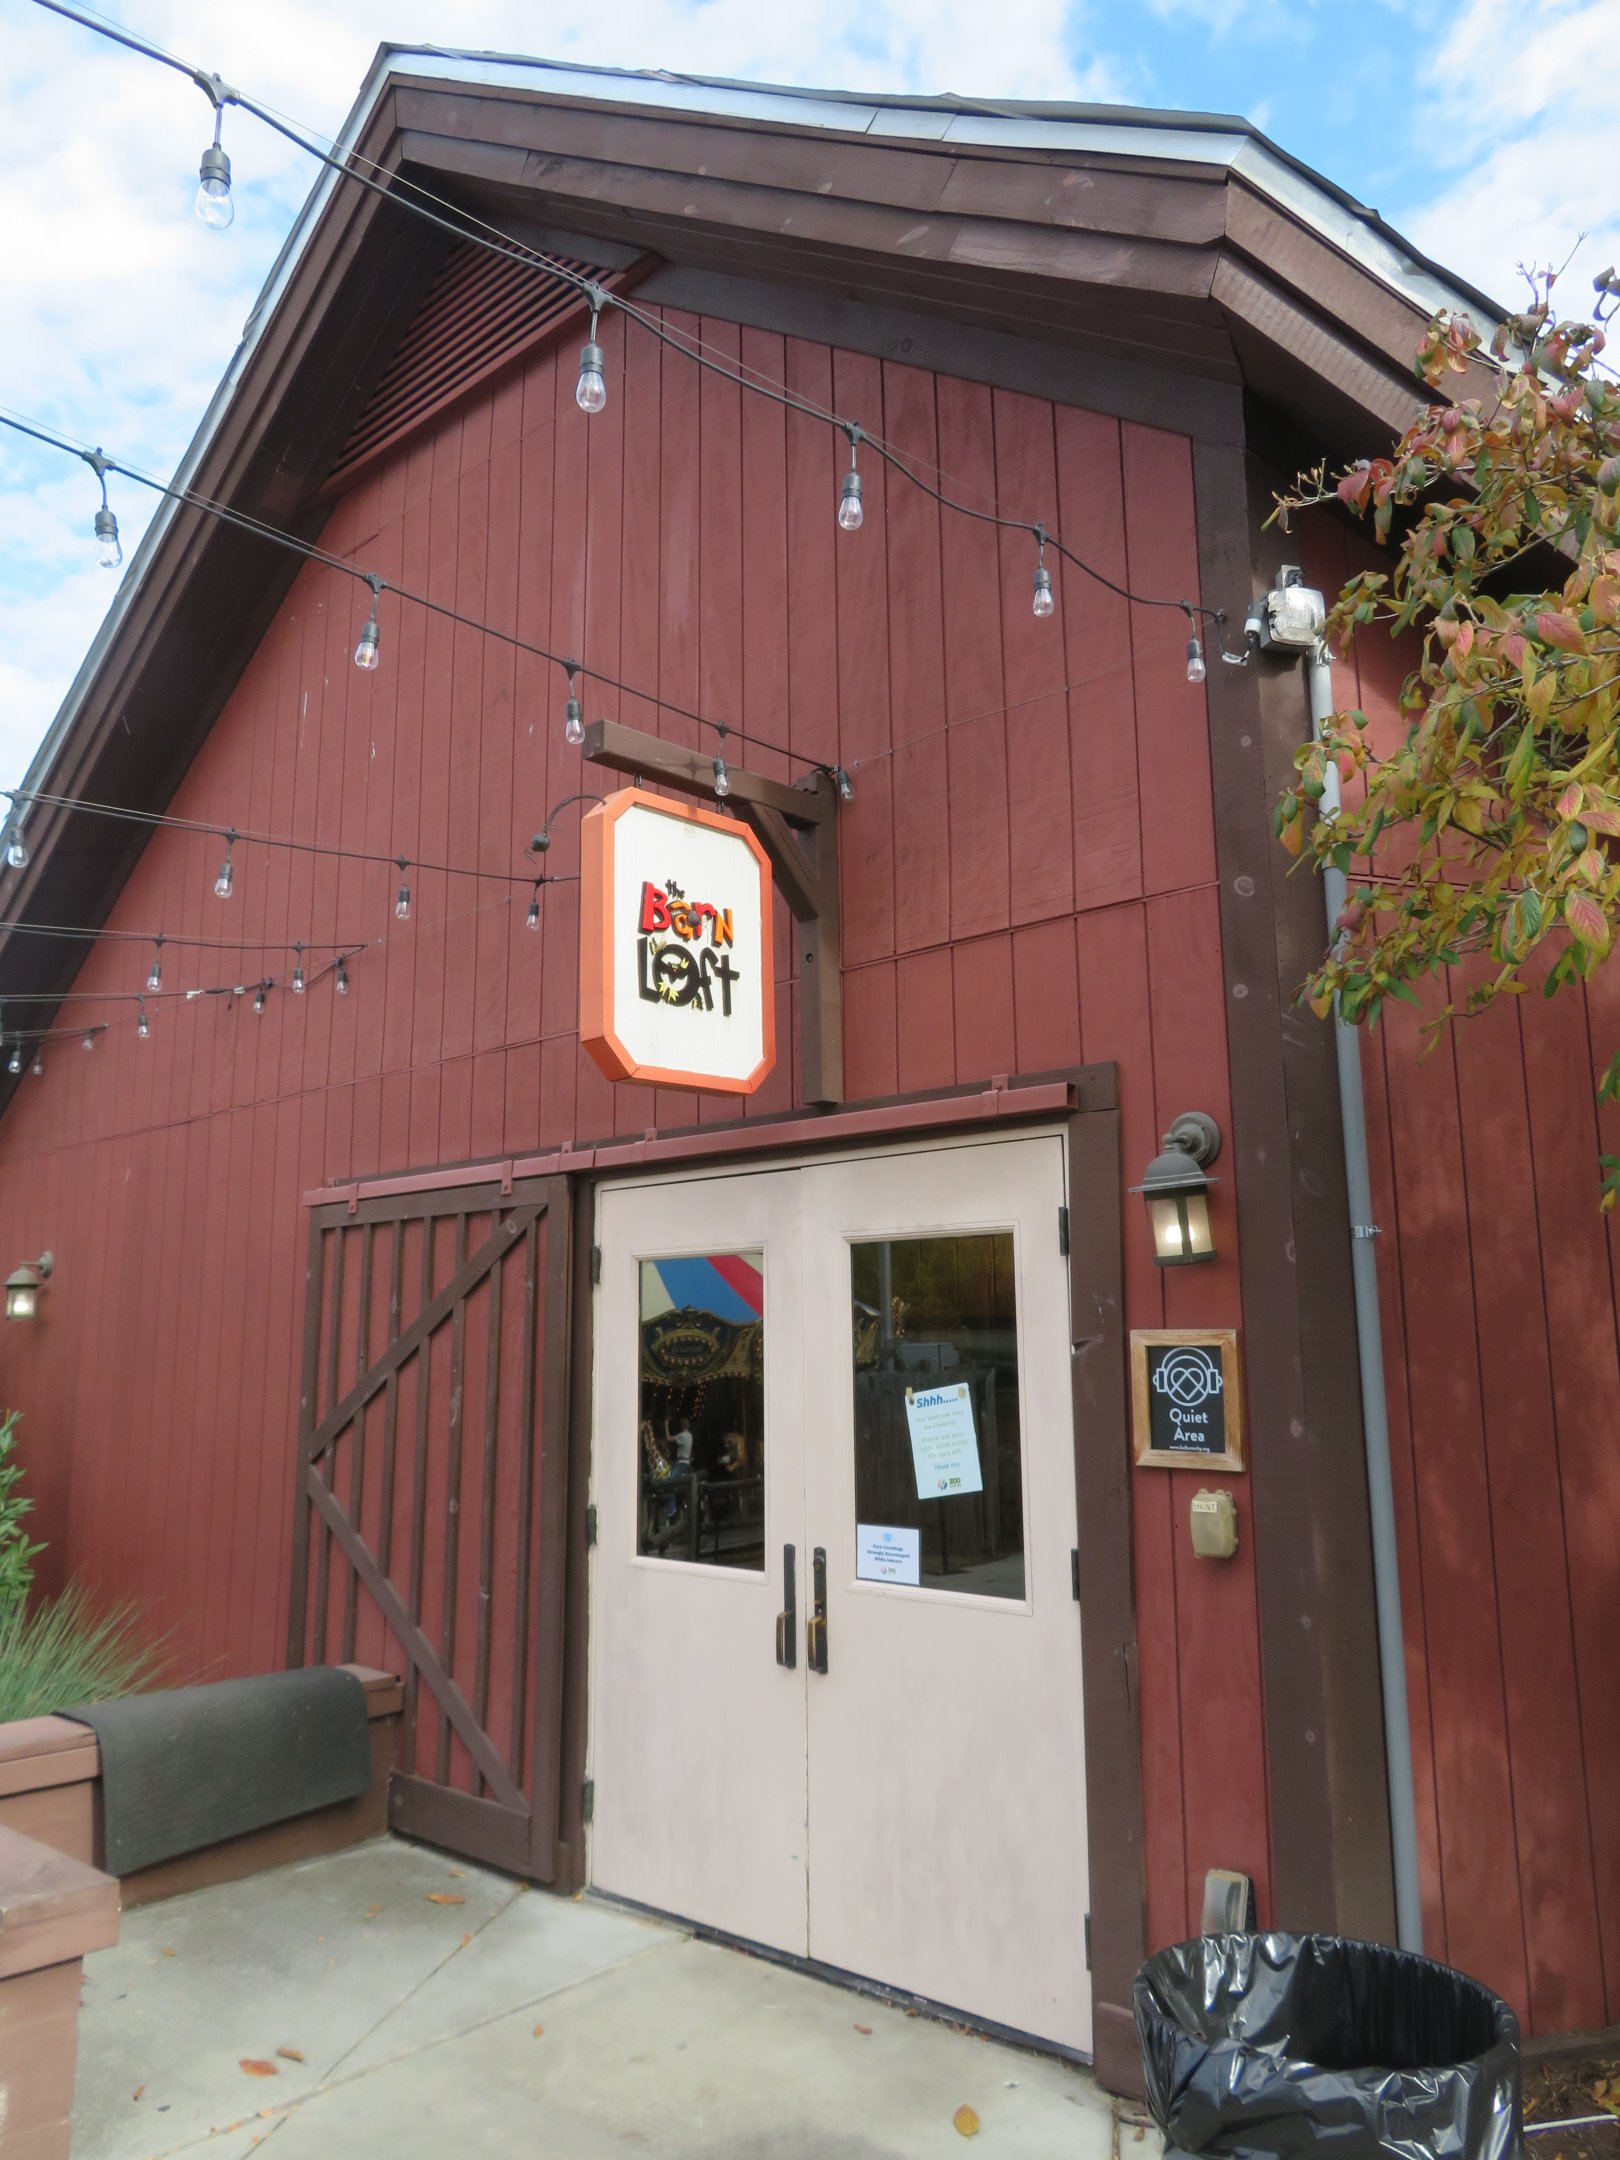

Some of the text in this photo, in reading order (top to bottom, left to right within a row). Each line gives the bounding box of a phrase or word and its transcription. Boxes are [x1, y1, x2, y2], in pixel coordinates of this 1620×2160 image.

[665, 879, 685, 899] the
[1169, 1408, 1208, 1426] Quiet
[1173, 1426, 1205, 1442] Area
